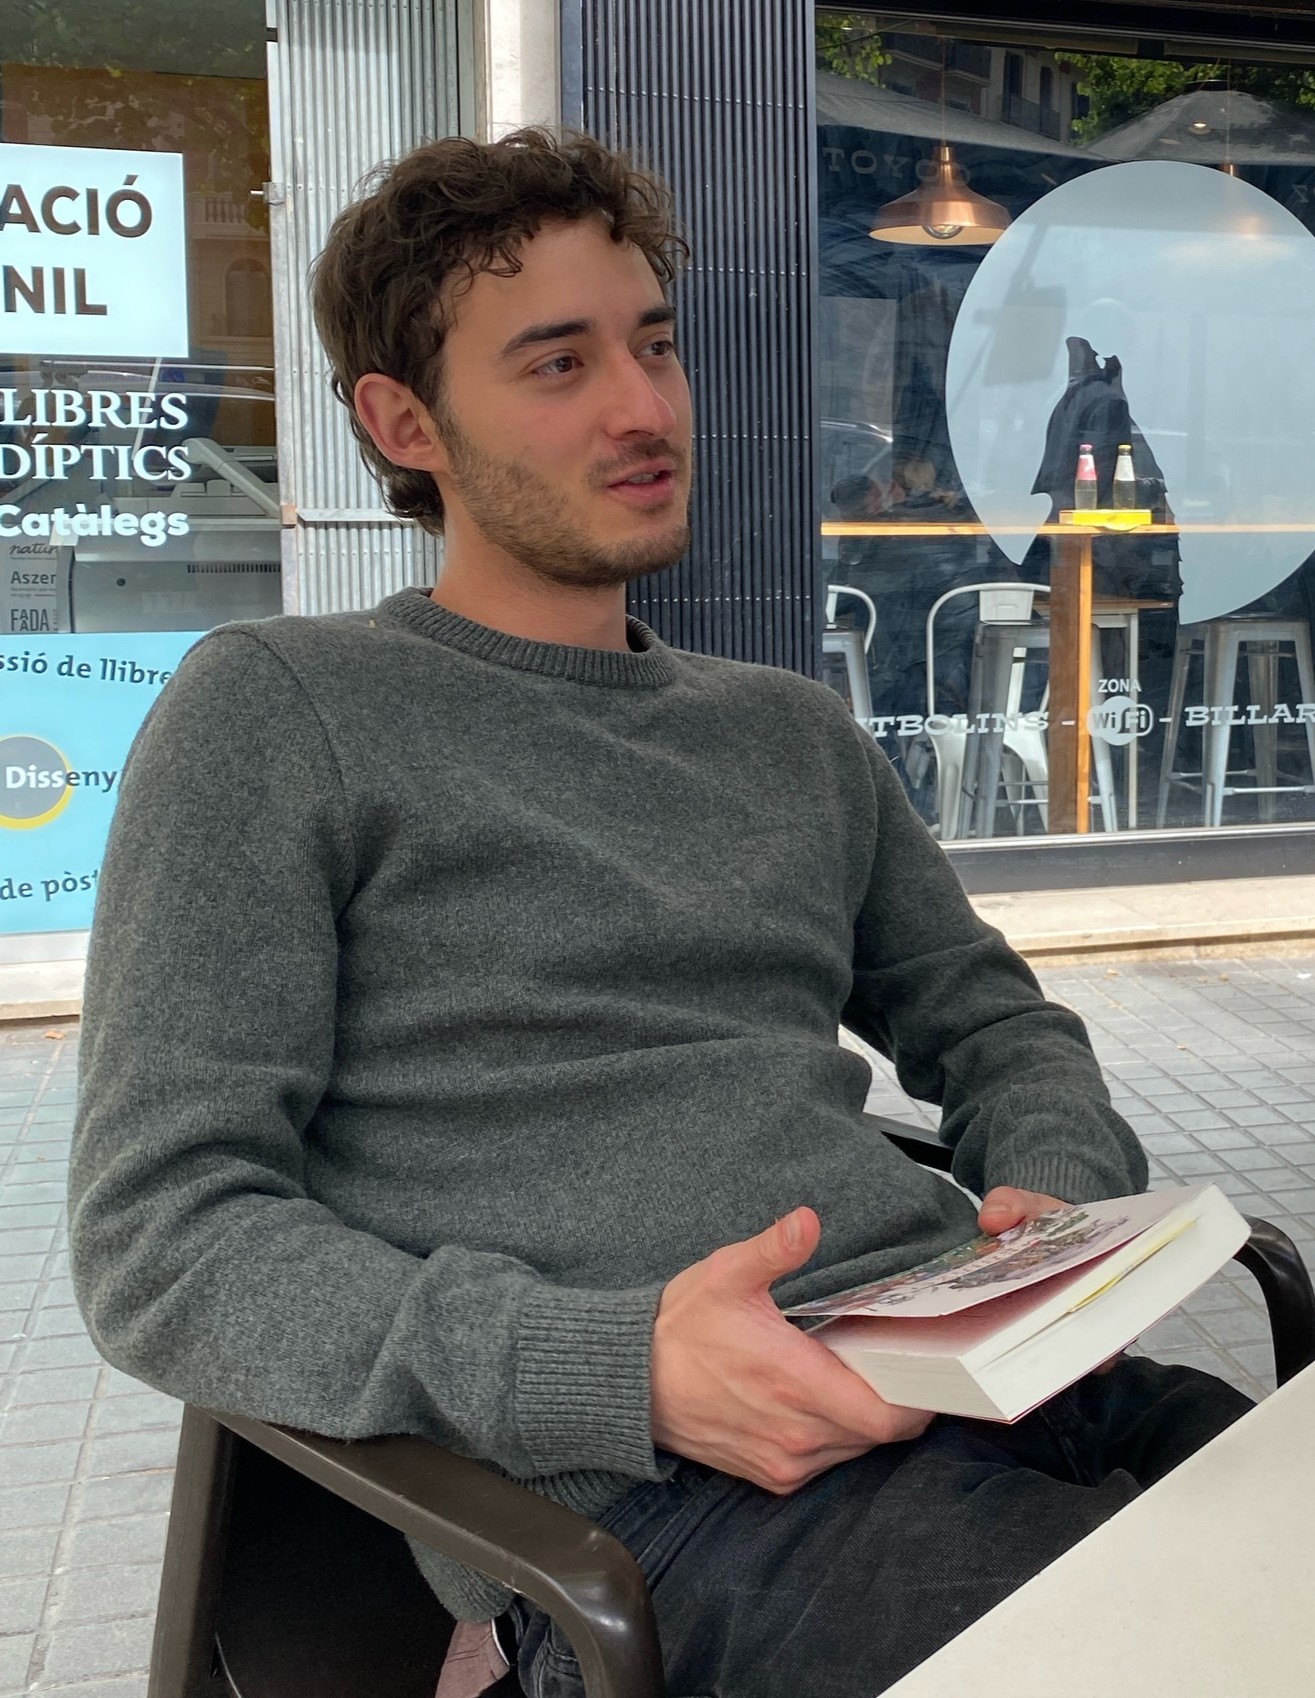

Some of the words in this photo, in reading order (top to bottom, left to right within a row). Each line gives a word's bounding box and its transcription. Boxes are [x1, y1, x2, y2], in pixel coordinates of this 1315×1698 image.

[0, 174, 152, 238] ACIÓ
[3, 265, 108, 316] NIL
[0, 388, 188, 430] LIBRES
[0, 433, 192, 481] DÍPTICS
[0, 504, 190, 547] Catàlegs
[57, 655, 91, 678] de
[1098, 679, 1141, 693] ZONA
[5, 764, 118, 793] Disseny
[0, 877, 33, 900] de
